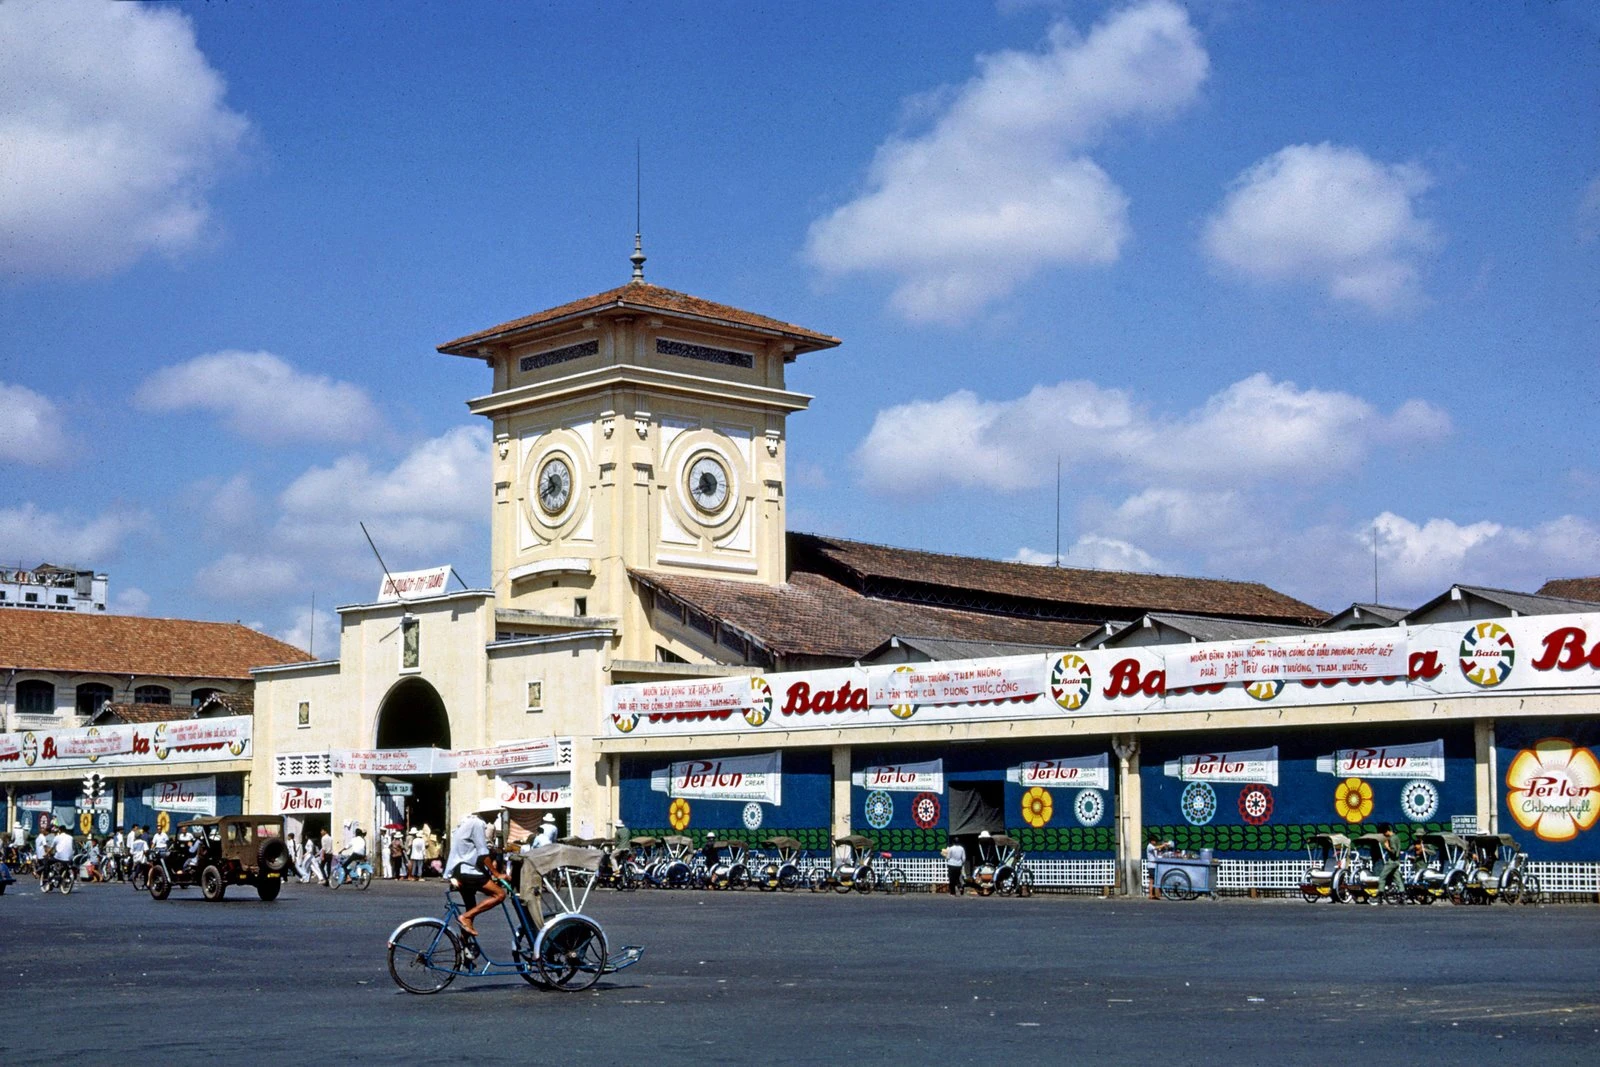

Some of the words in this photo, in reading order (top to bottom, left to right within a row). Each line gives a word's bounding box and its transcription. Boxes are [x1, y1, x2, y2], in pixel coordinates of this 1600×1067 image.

[1247, 646, 1265, 657] NÔNG
[1268, 647, 1287, 657] THÔN
[1475, 649, 1501, 657] Bata
[781, 680, 868, 716] Bata
[1028, 760, 1078, 780] Perlon
[1188, 753, 1245, 775] Perlon
[1343, 748, 1407, 771] Perlon
[678, 760, 743, 789] Perlon
[873, 766, 916, 784] Perlon
[502, 780, 559, 803] Perlon
[1523, 776, 1591, 798] Perlon
[281, 787, 322, 811] Perlon
[1522, 799, 1592, 820] Chlorophyll
